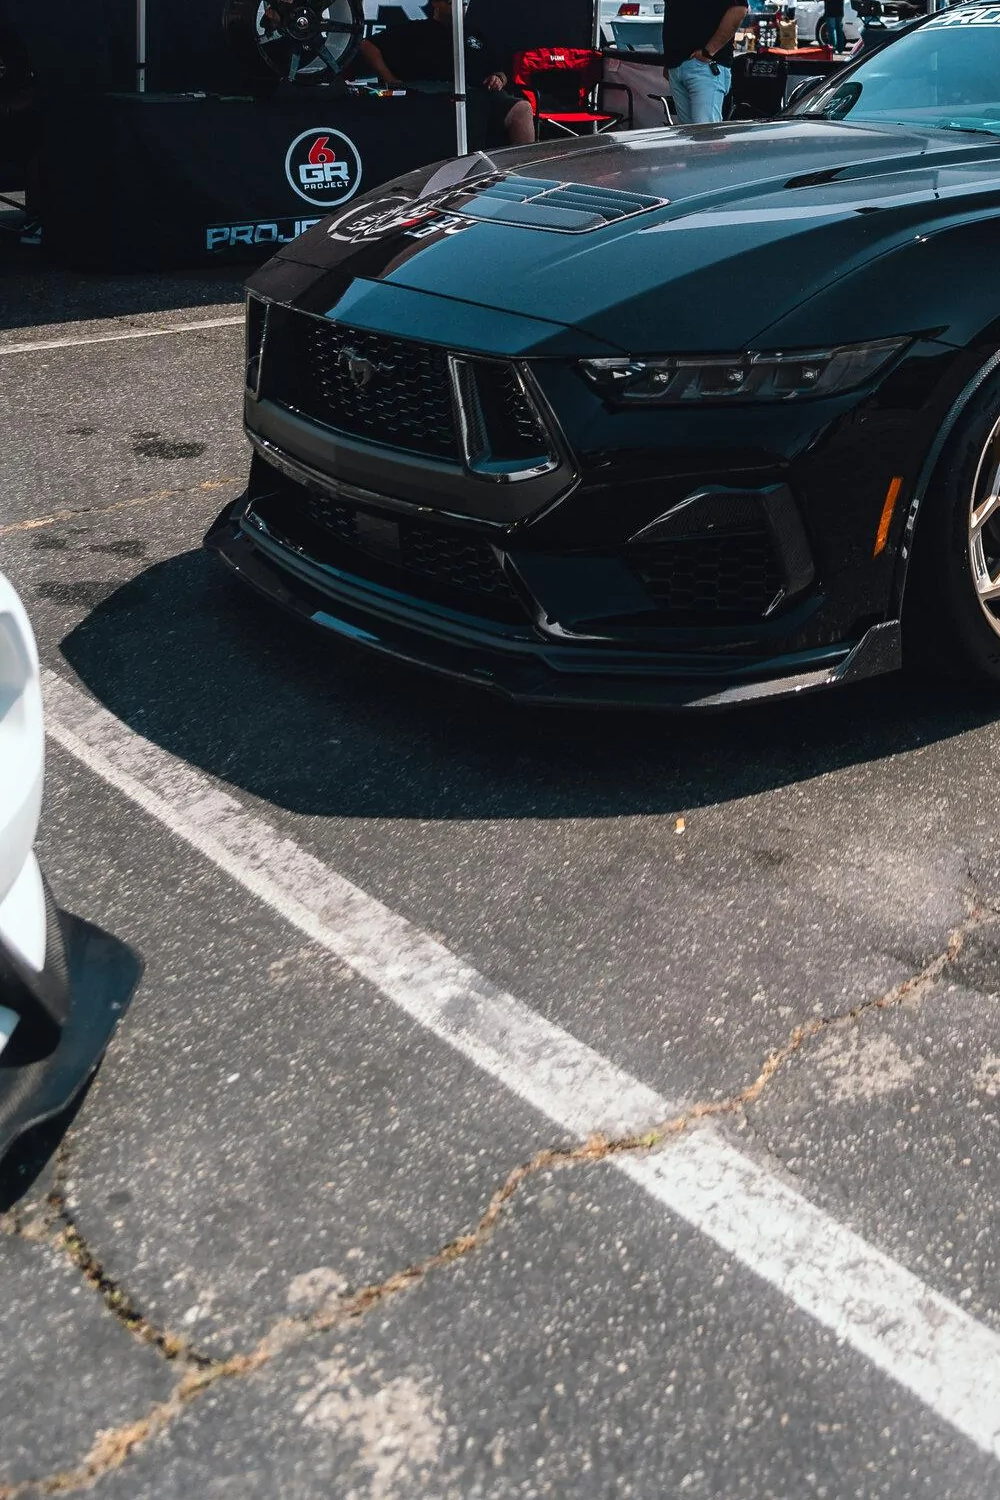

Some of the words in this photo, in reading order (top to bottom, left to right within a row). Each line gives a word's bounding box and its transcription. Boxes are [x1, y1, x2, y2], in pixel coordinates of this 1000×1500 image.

[308, 136, 336, 164] 6
[299, 161, 350, 184] GR
[304, 180, 349, 190] PROJECT
